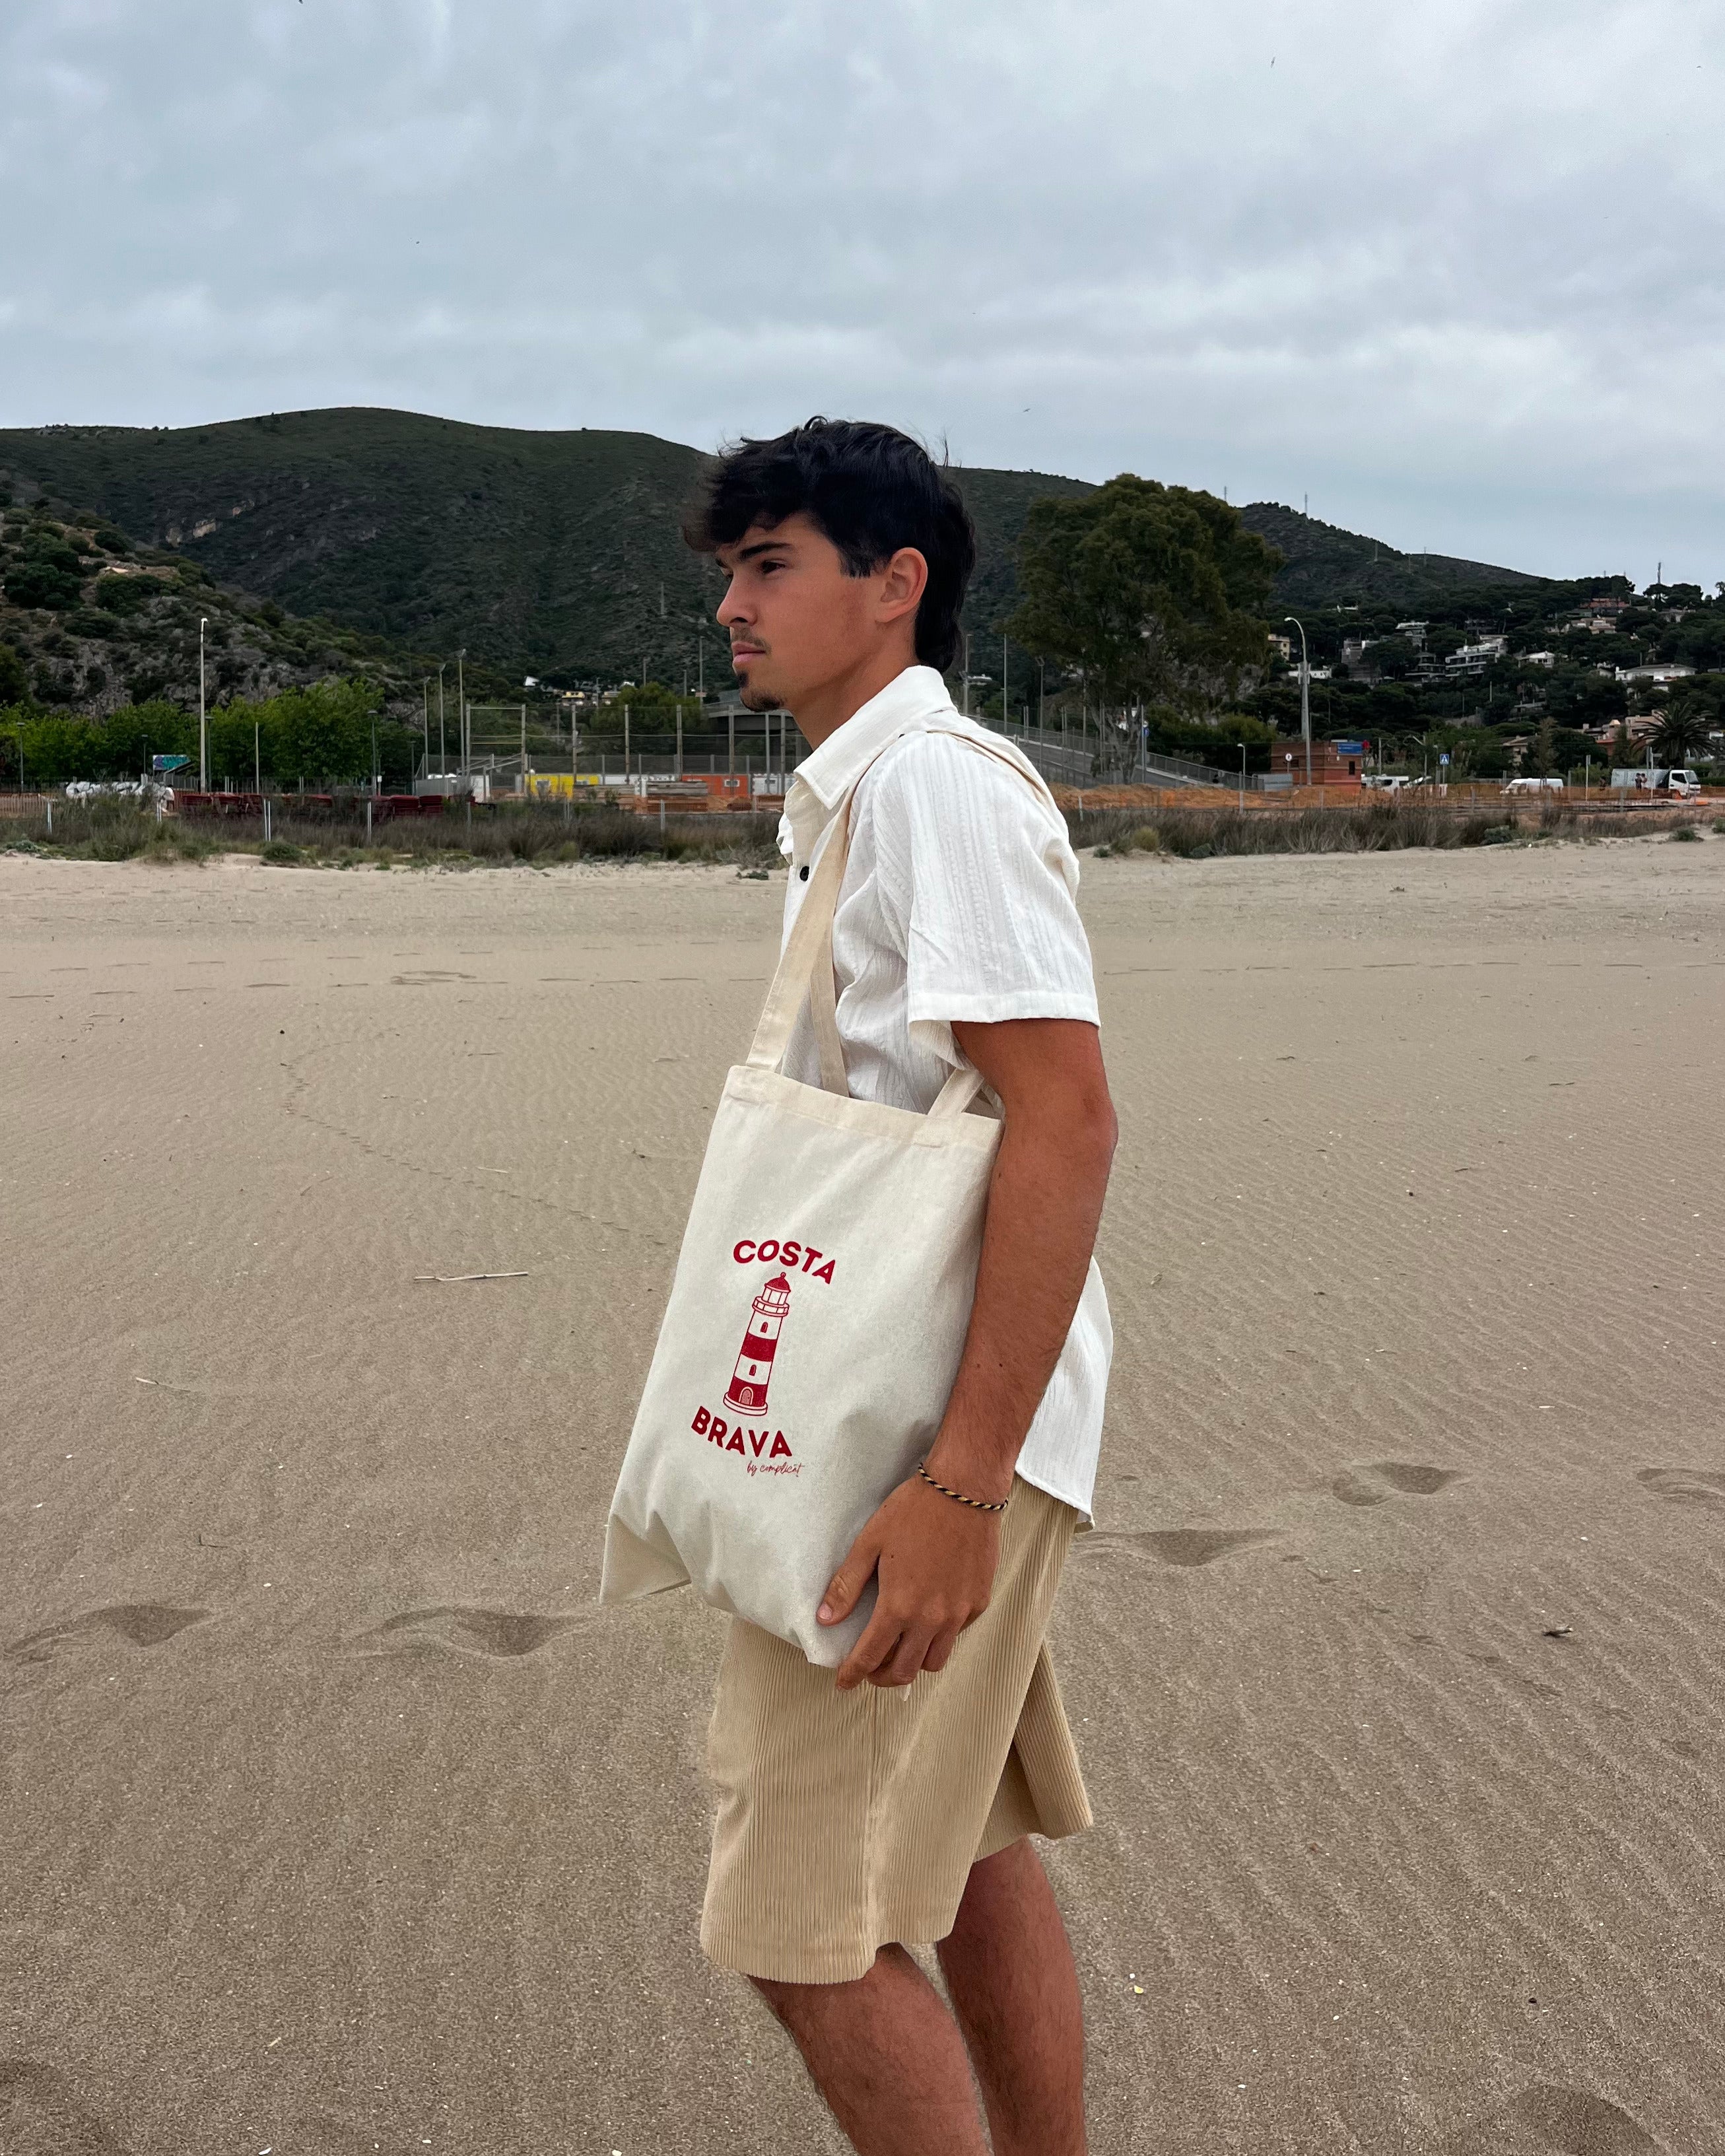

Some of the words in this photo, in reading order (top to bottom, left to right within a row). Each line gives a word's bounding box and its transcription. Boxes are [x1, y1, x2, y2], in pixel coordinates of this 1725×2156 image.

[733, 1240, 836, 1284] COSTA
[691, 1405, 792, 1458] BRAVA
[747, 1460, 758, 1477] by
